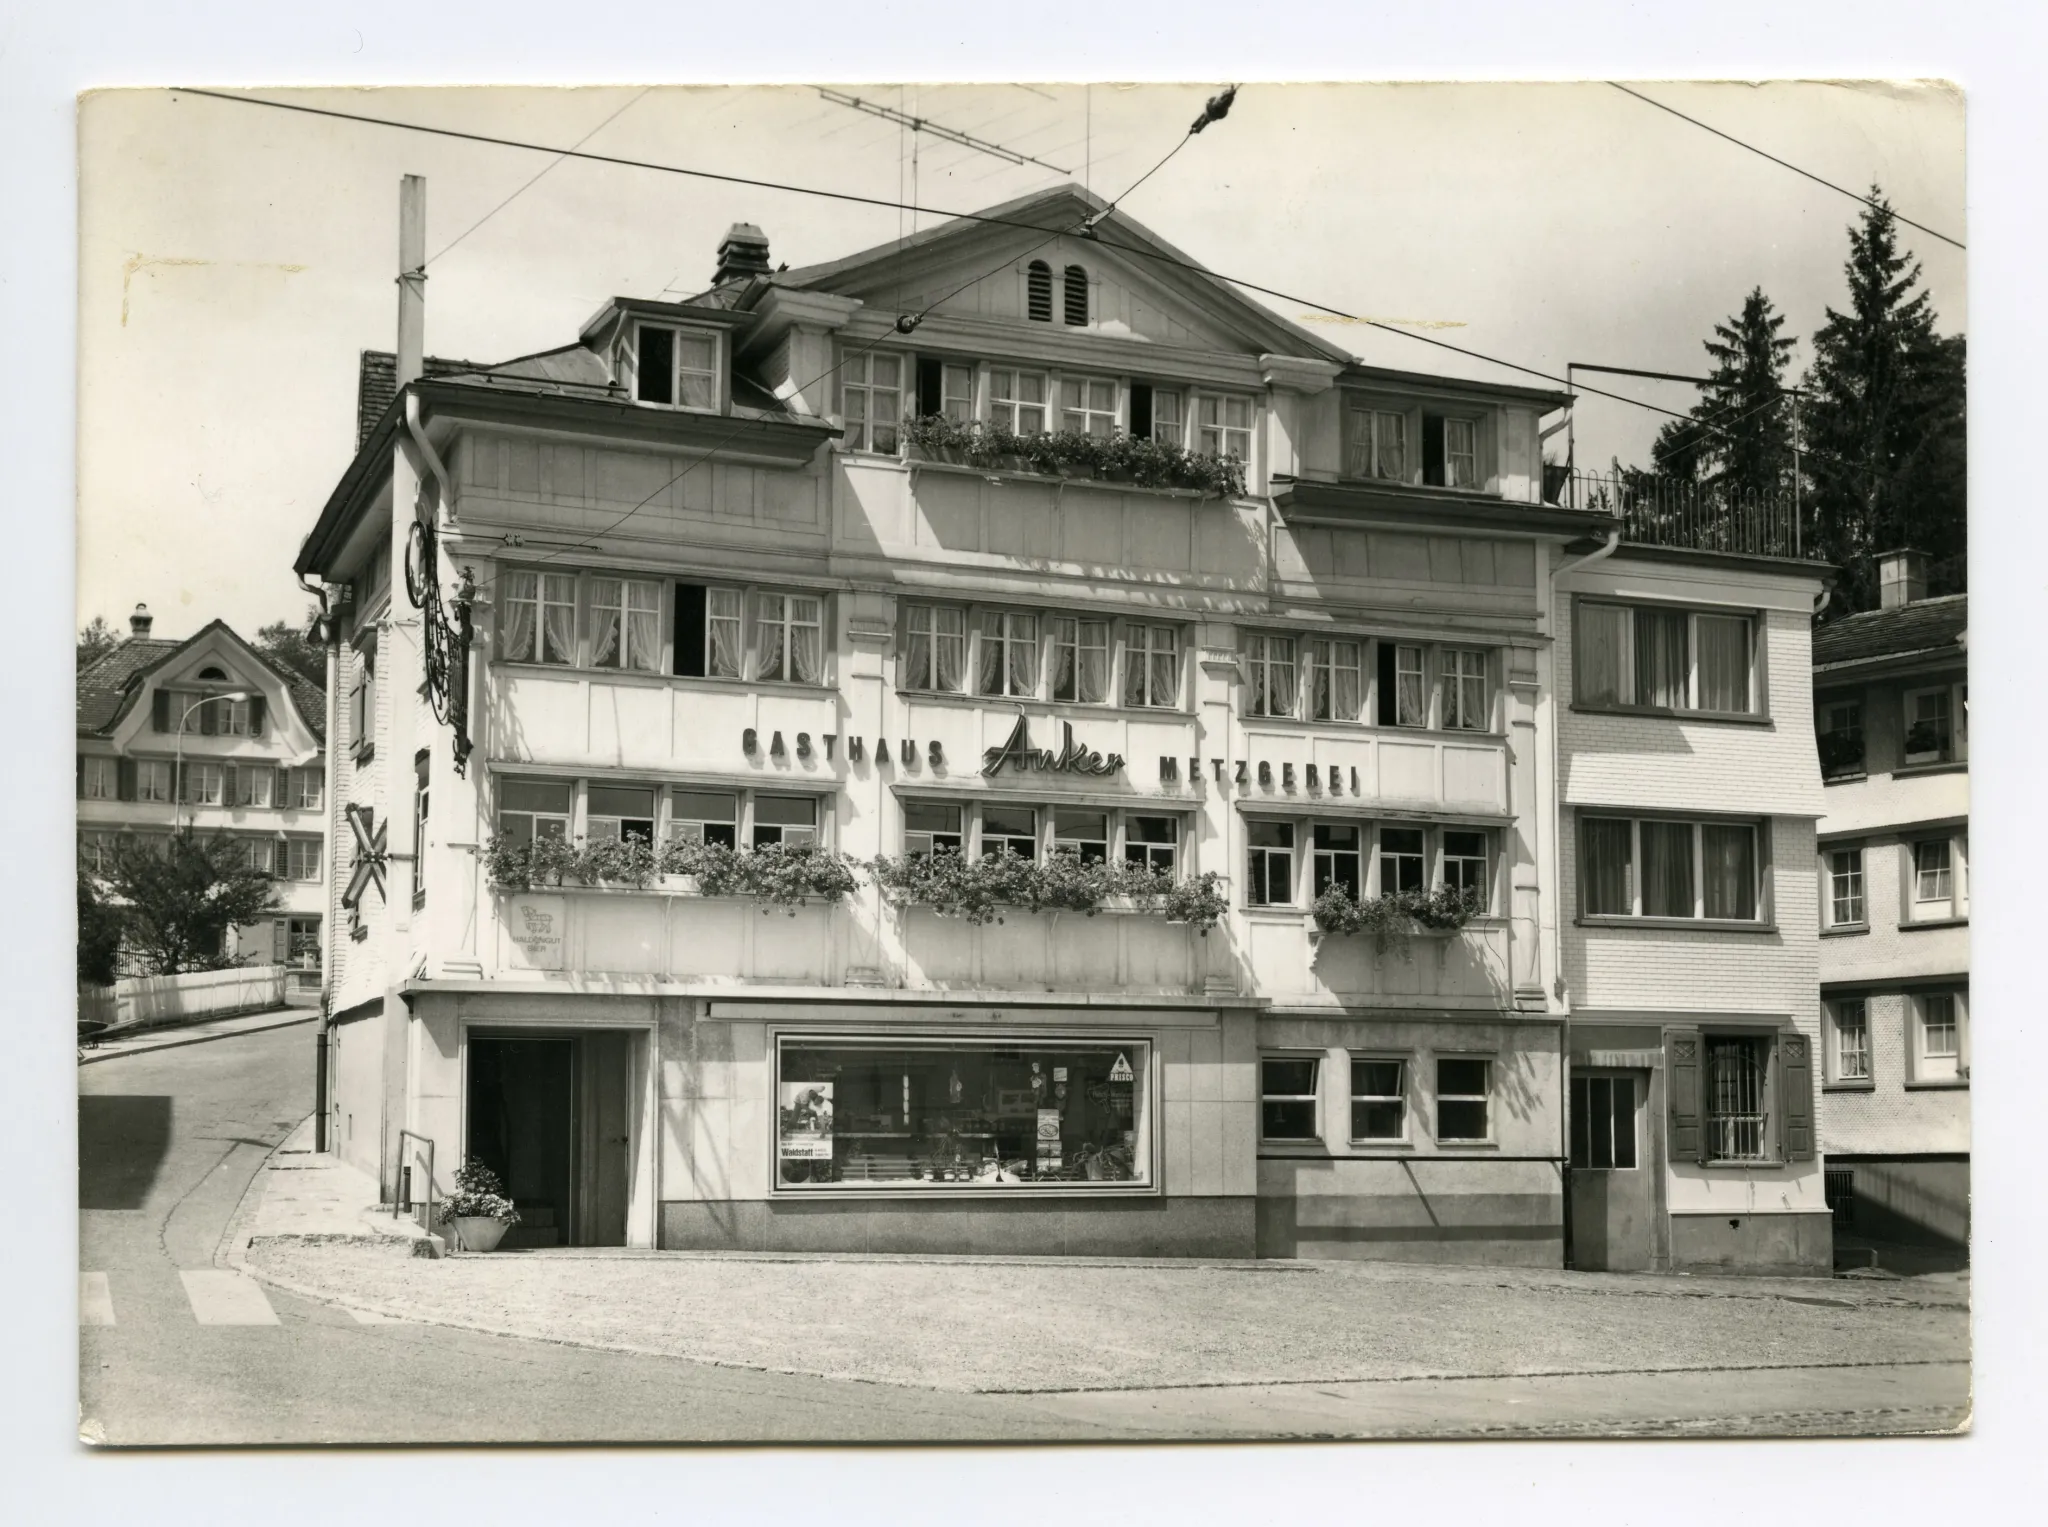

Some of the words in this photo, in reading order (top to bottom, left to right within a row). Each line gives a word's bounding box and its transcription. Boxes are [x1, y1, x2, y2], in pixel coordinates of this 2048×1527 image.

[742, 728, 943, 767] GASTHAUS
[981, 714, 1126, 778] Anker
[1159, 756, 1356, 789] METZGEREI
[781, 1148, 813, 1157] Waldstatt
